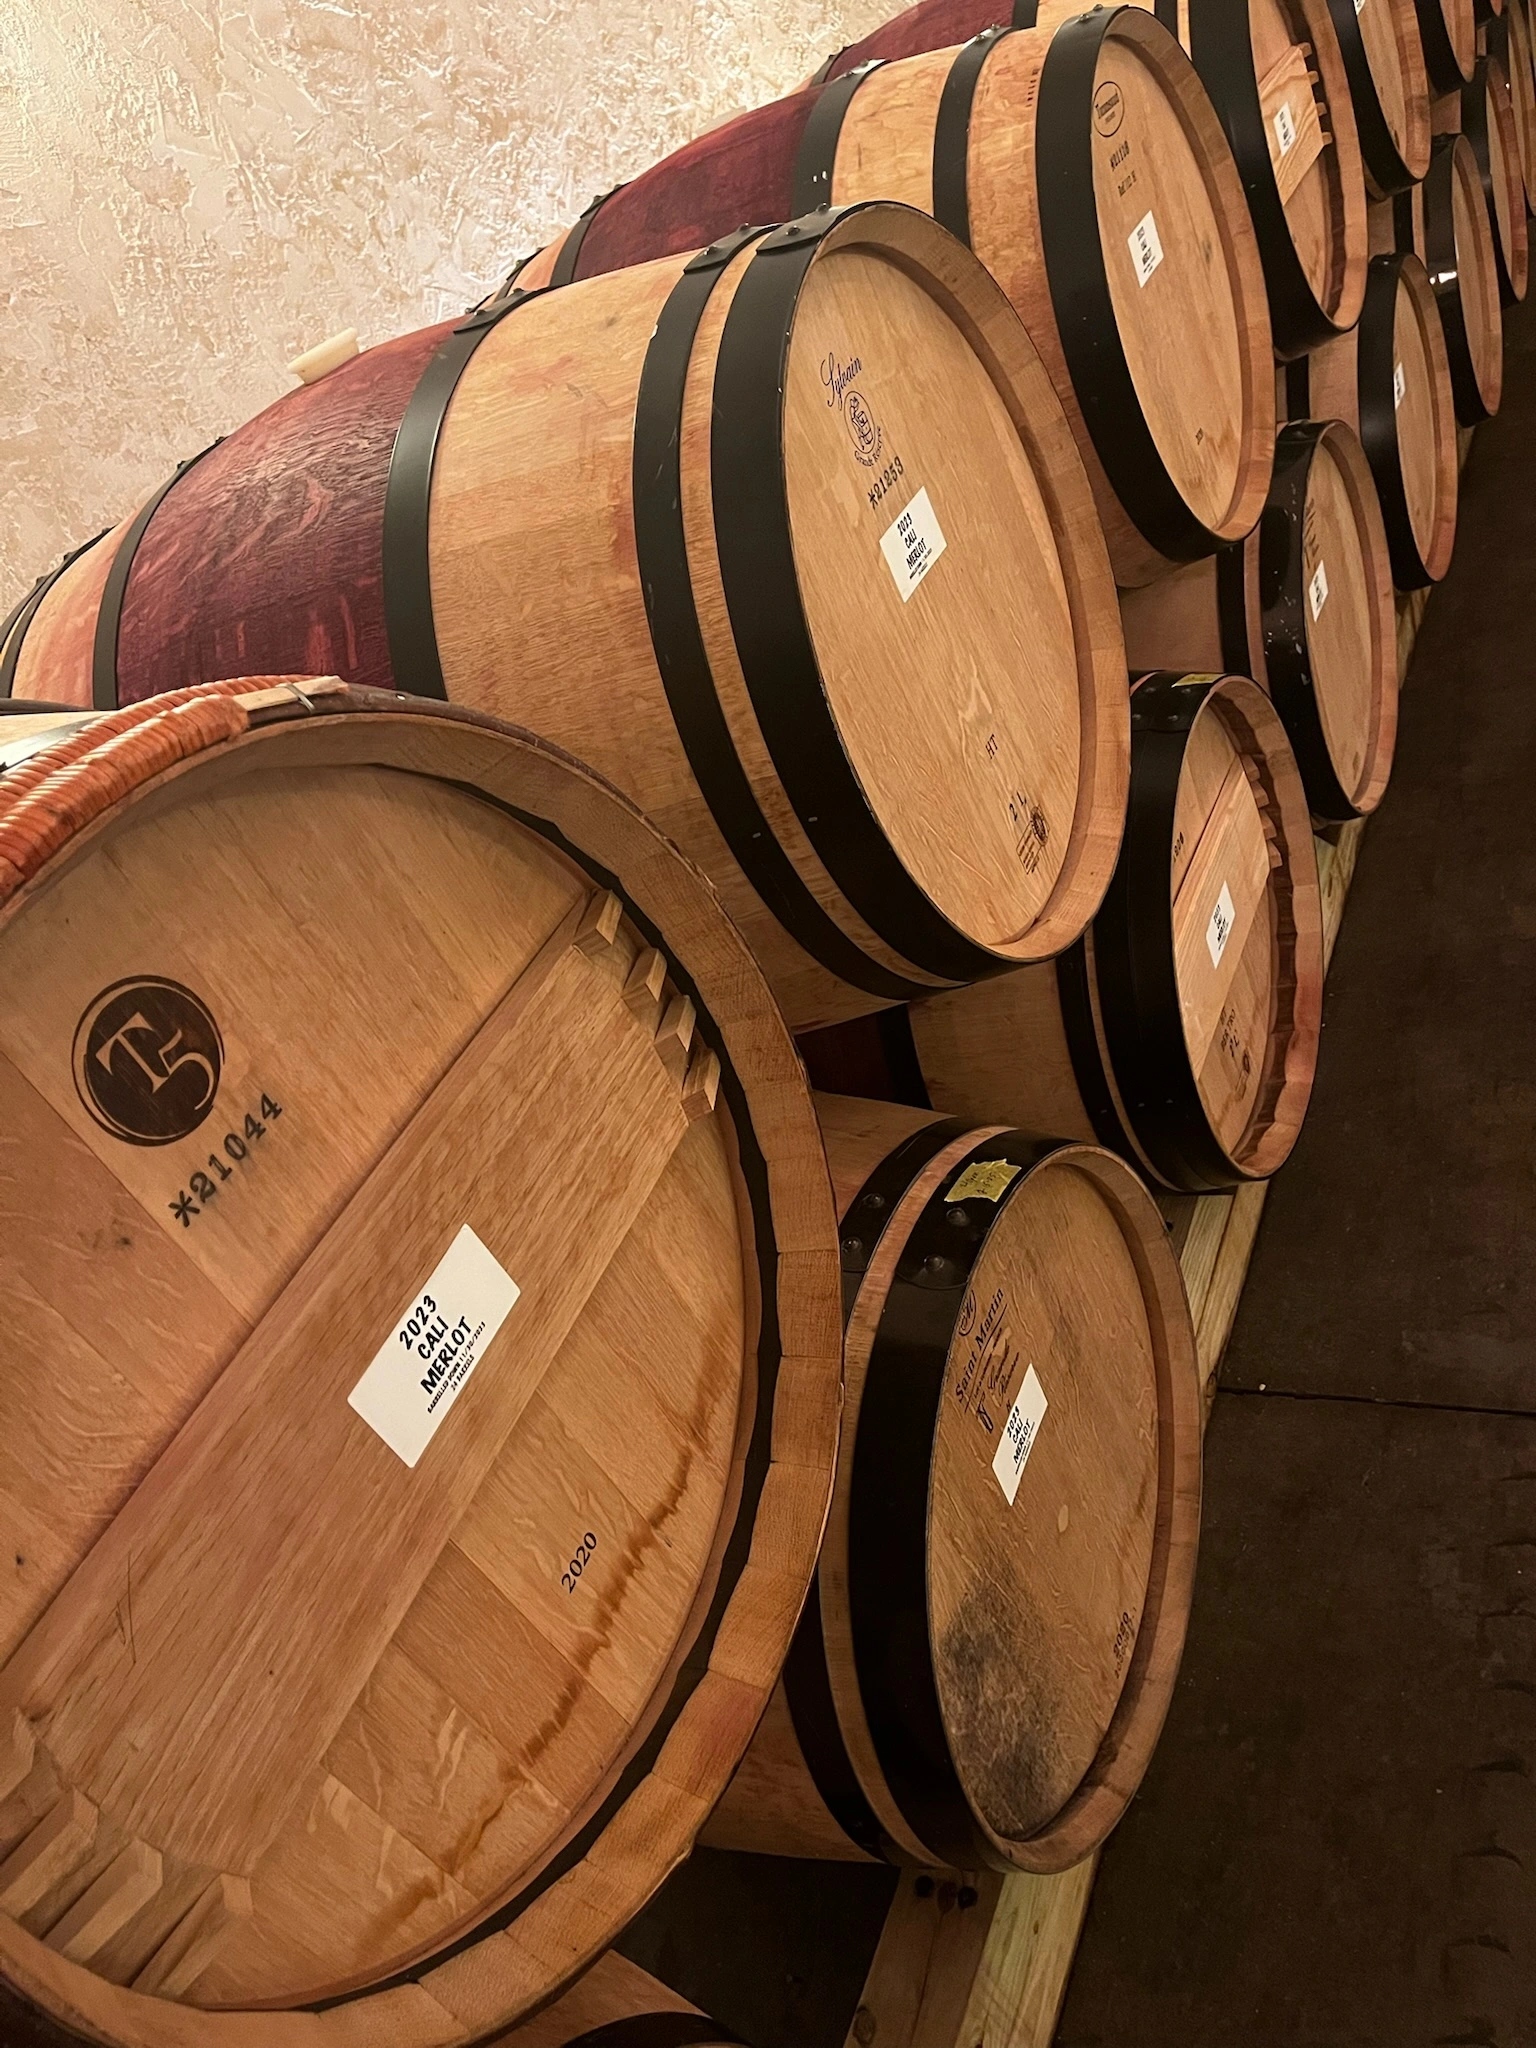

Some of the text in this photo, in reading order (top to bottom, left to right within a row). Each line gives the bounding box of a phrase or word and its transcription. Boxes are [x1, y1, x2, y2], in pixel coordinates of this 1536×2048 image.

[820, 352, 862, 411] Sylvain
[897, 512, 912, 537] 2023
[905, 528, 917, 549] CALI
[906, 537, 927, 570] MERLOT
[400, 1294, 437, 1350] 2023
[418, 1315, 449, 1359] CALI
[420, 1316, 471, 1395] MERLOT
[955, 1351, 978, 1404] Saint
[975, 1288, 1004, 1349] Martin
[1012, 1417, 1024, 1444] CALI
[1013, 1417, 1031, 1464] MERLOT
[561, 1532, 597, 1594] 2020
